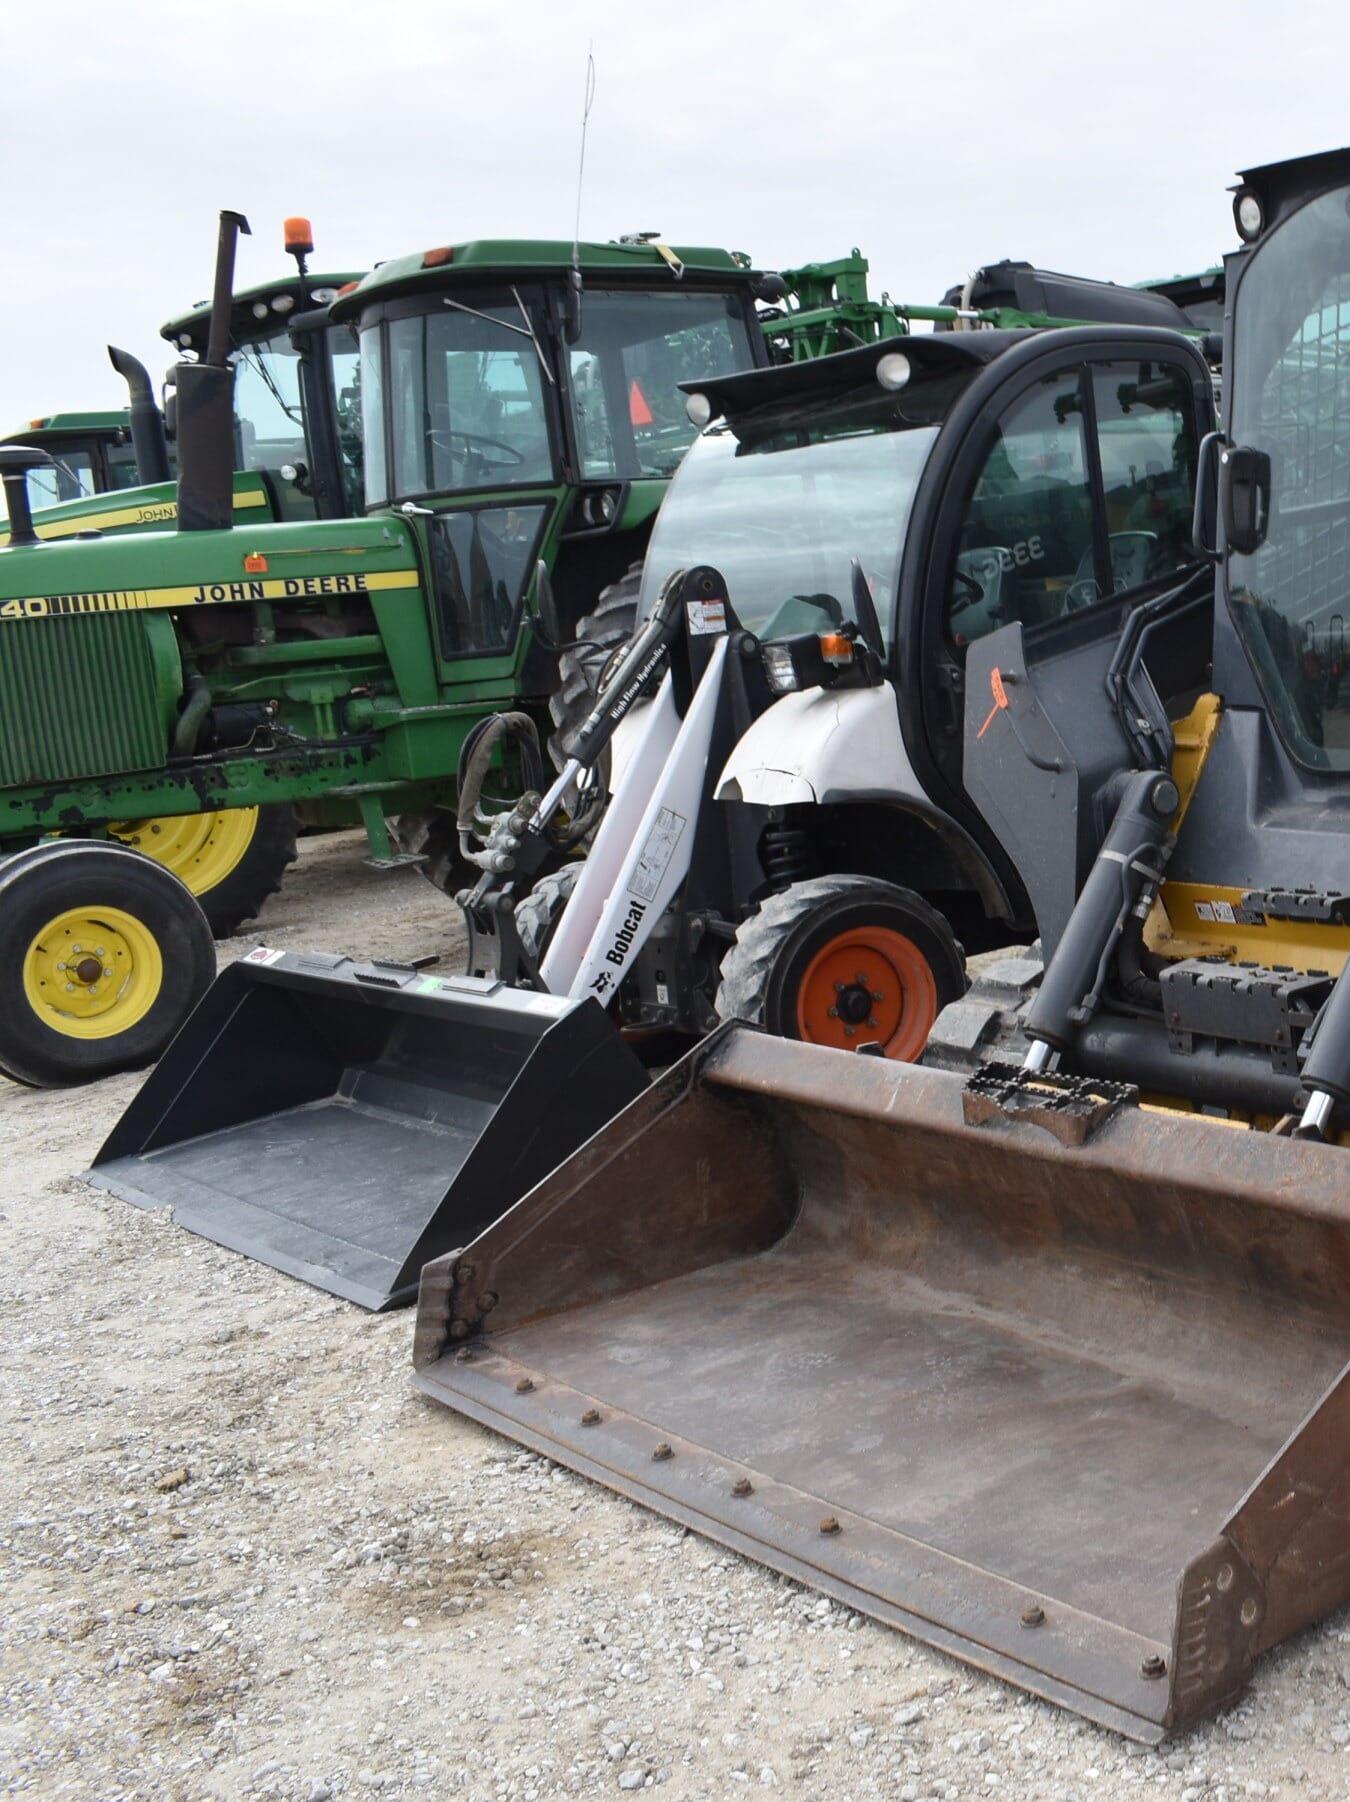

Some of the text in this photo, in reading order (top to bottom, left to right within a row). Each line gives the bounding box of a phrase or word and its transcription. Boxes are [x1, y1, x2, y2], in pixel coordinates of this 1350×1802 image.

[136, 509, 174, 523] JOHN
[194, 574, 368, 603] JOHN DEERE
[1, 598, 47, 618] 40
[623, 682, 640, 702] Flow
[636, 642, 667, 682] Hydraulics
[605, 900, 647, 966] Bobcat
